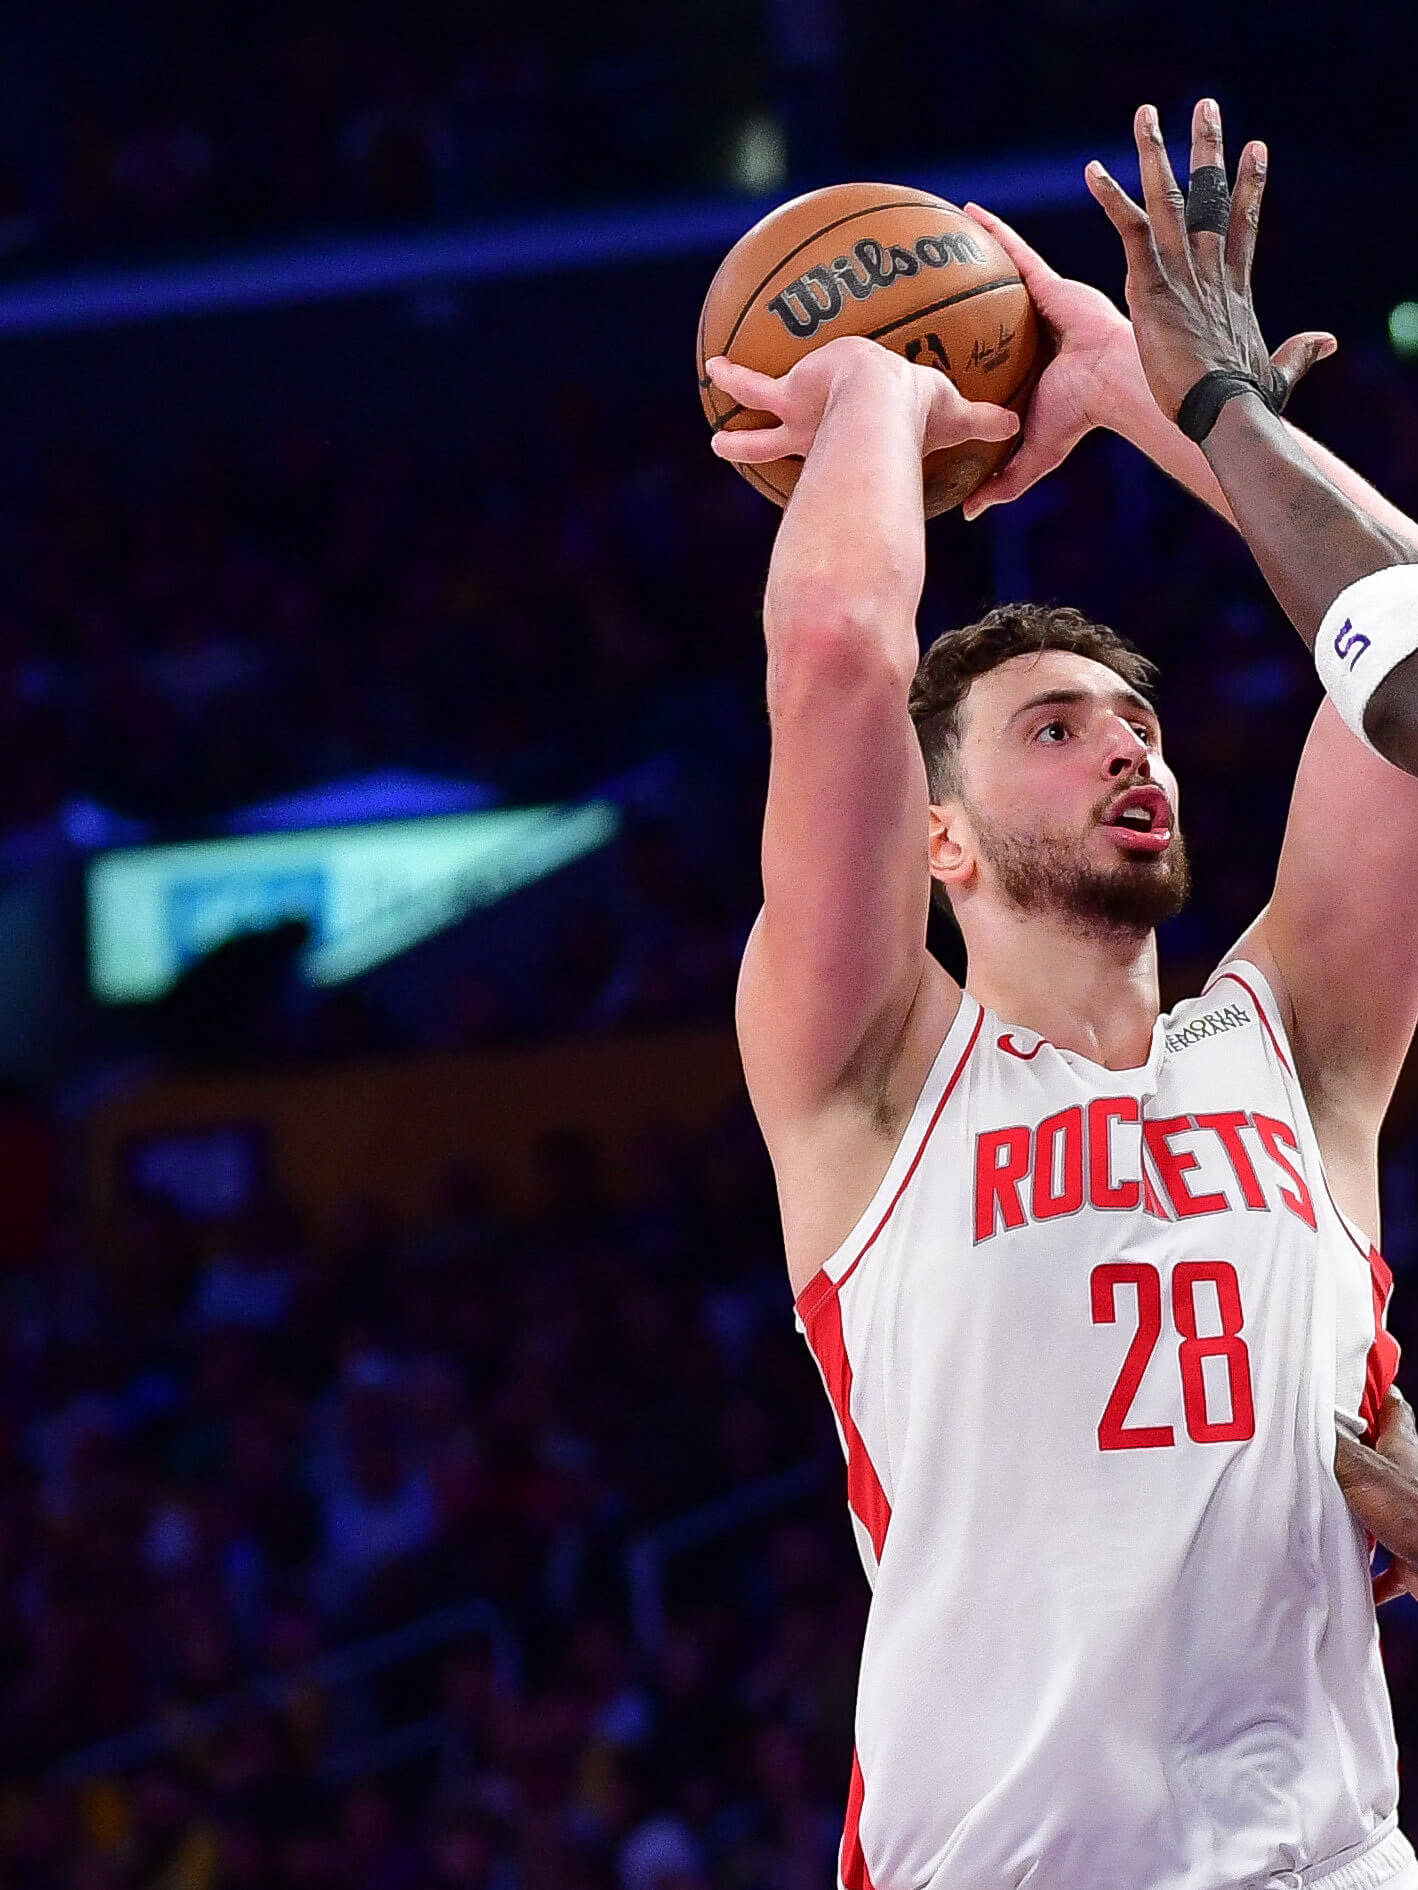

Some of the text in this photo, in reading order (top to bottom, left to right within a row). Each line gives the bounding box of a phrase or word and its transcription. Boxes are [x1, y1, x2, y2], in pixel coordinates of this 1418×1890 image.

[767, 231, 987, 340] Wilson
[1334, 617, 1372, 673] 5
[1165, 1003, 1245, 1044] EMORIAL
[1089, 1260, 1257, 1452] 28
